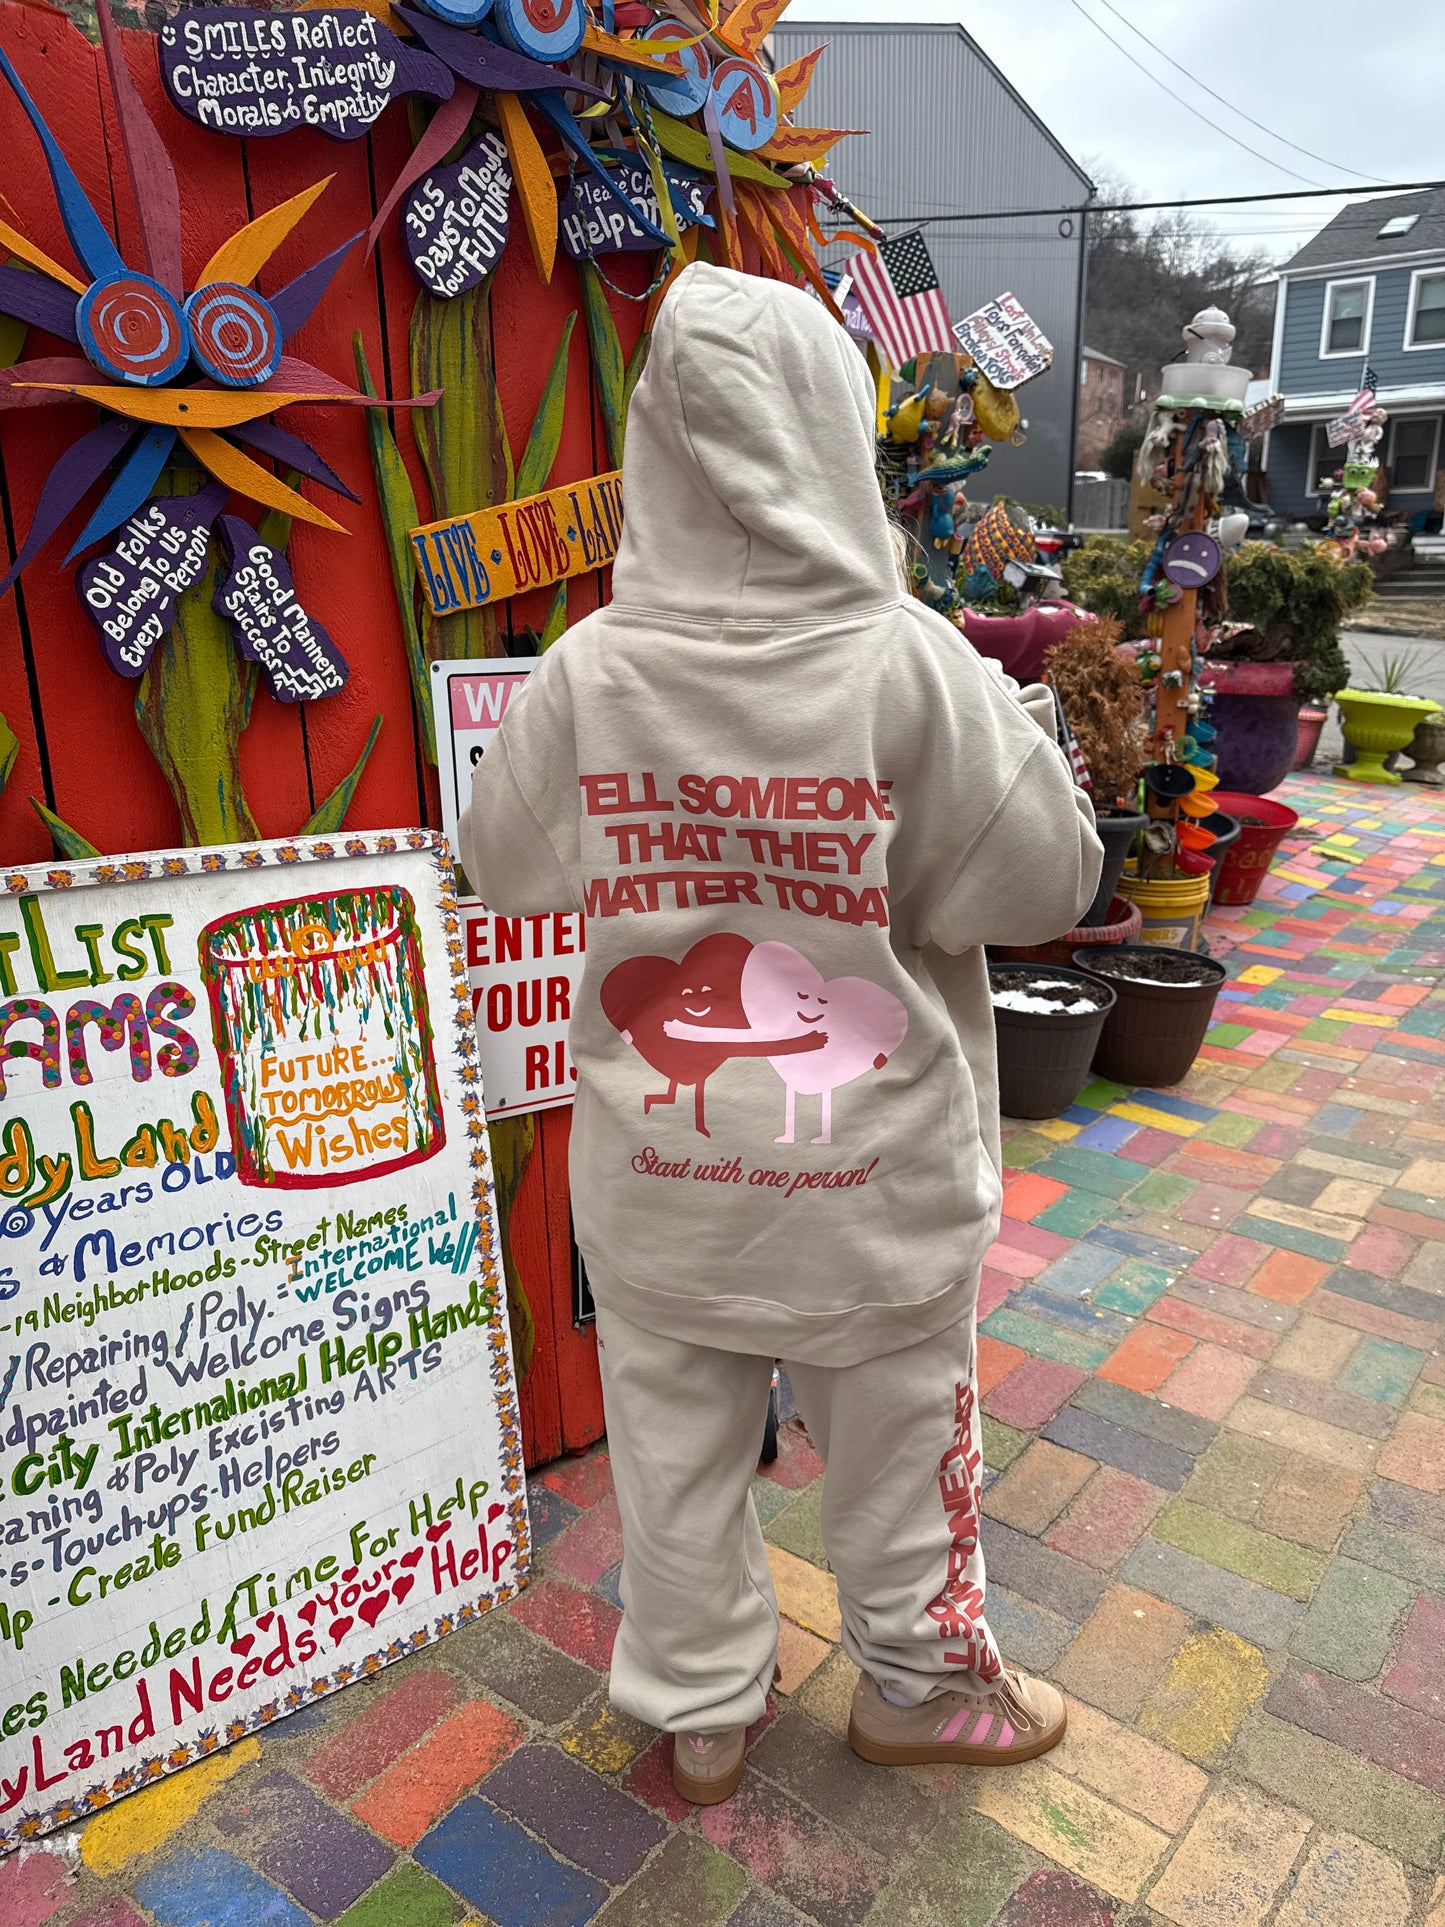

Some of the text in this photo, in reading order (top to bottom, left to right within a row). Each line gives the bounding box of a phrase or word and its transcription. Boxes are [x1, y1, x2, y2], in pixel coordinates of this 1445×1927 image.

[184, 12, 377, 55] SMILES Reflect
[173, 52, 396, 97] Character, Integrity
[198, 97, 282, 127] Morals
[303, 92, 391, 133] Empathy
[406, 178, 445, 238] 365
[415, 132, 508, 279] Days To Mould
[432, 167, 512, 297] Your FUTURE
[563, 206, 625, 254] Help
[86, 506, 167, 609] Old Folks
[103, 526, 187, 642] Belong To Us
[413, 519, 491, 612] LIVE
[497, 496, 570, 590] LOVE
[120, 613, 163, 668] Every
[164, 525, 211, 593] Person
[225, 590, 282, 671] Success
[235, 566, 292, 654] Stairs To
[248, 545, 344, 689] Good Manners
[677, 774, 896, 821] SOMEONE
[605, 822, 877, 875] THAT THEY
[466, 913, 586, 967] ENTE
[261, 1072, 407, 1116] TOMORROWS
[162, 1151, 236, 1192] OLD
[276, 1116, 409, 1169] Wishes
[631, 1147, 880, 1198] Start with one person!
[73, 1210, 283, 1282] Memories
[285, 1192, 457, 1284] International
[336, 1204, 408, 1243] Names
[295, 1237, 423, 1303] WELCOME
[165, 1319, 325, 1387] Welcome
[333, 1279, 431, 1332] Signs
[11, 1433, 100, 1496] City
[319, 1332, 402, 1384] Help
[408, 1280, 495, 1348] Hands
[134, 1446, 200, 1493] Poly
[208, 1391, 345, 1460] Excisting
[353, 1342, 442, 1402] ARTS
[350, 1521, 400, 1565] For
[409, 1477, 489, 1536] Help
[170, 1614, 317, 1725] Needs
[315, 1559, 397, 1615] Your
[431, 1523, 512, 1595] Help
